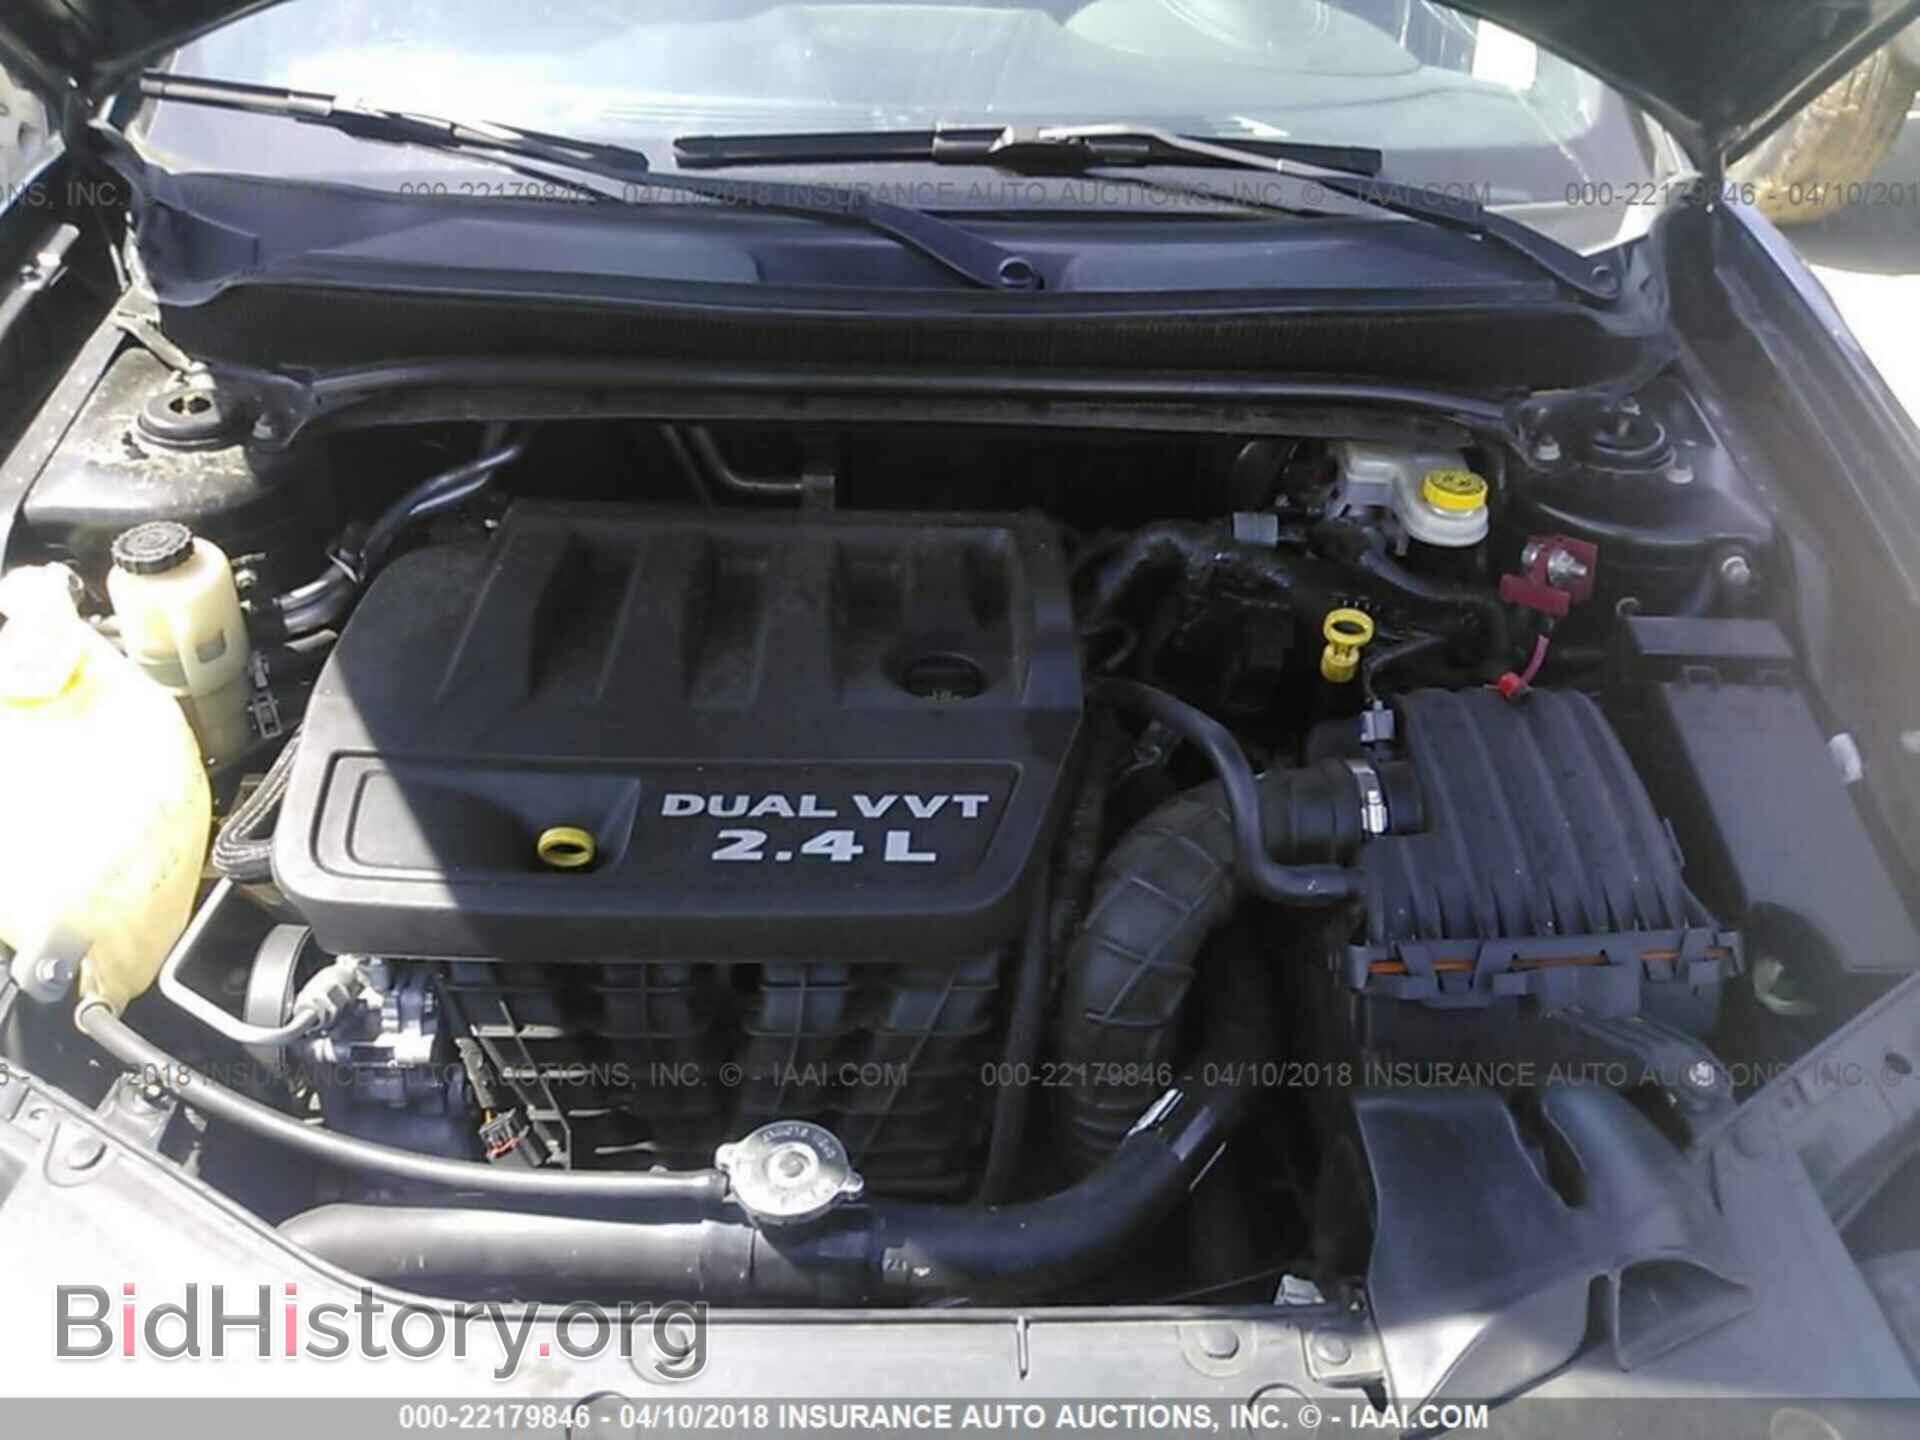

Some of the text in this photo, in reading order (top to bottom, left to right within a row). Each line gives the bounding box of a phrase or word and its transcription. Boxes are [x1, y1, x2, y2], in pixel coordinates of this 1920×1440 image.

[661, 794, 989, 819] DUAL VVT
[711, 829, 937, 862] 2.4 L
